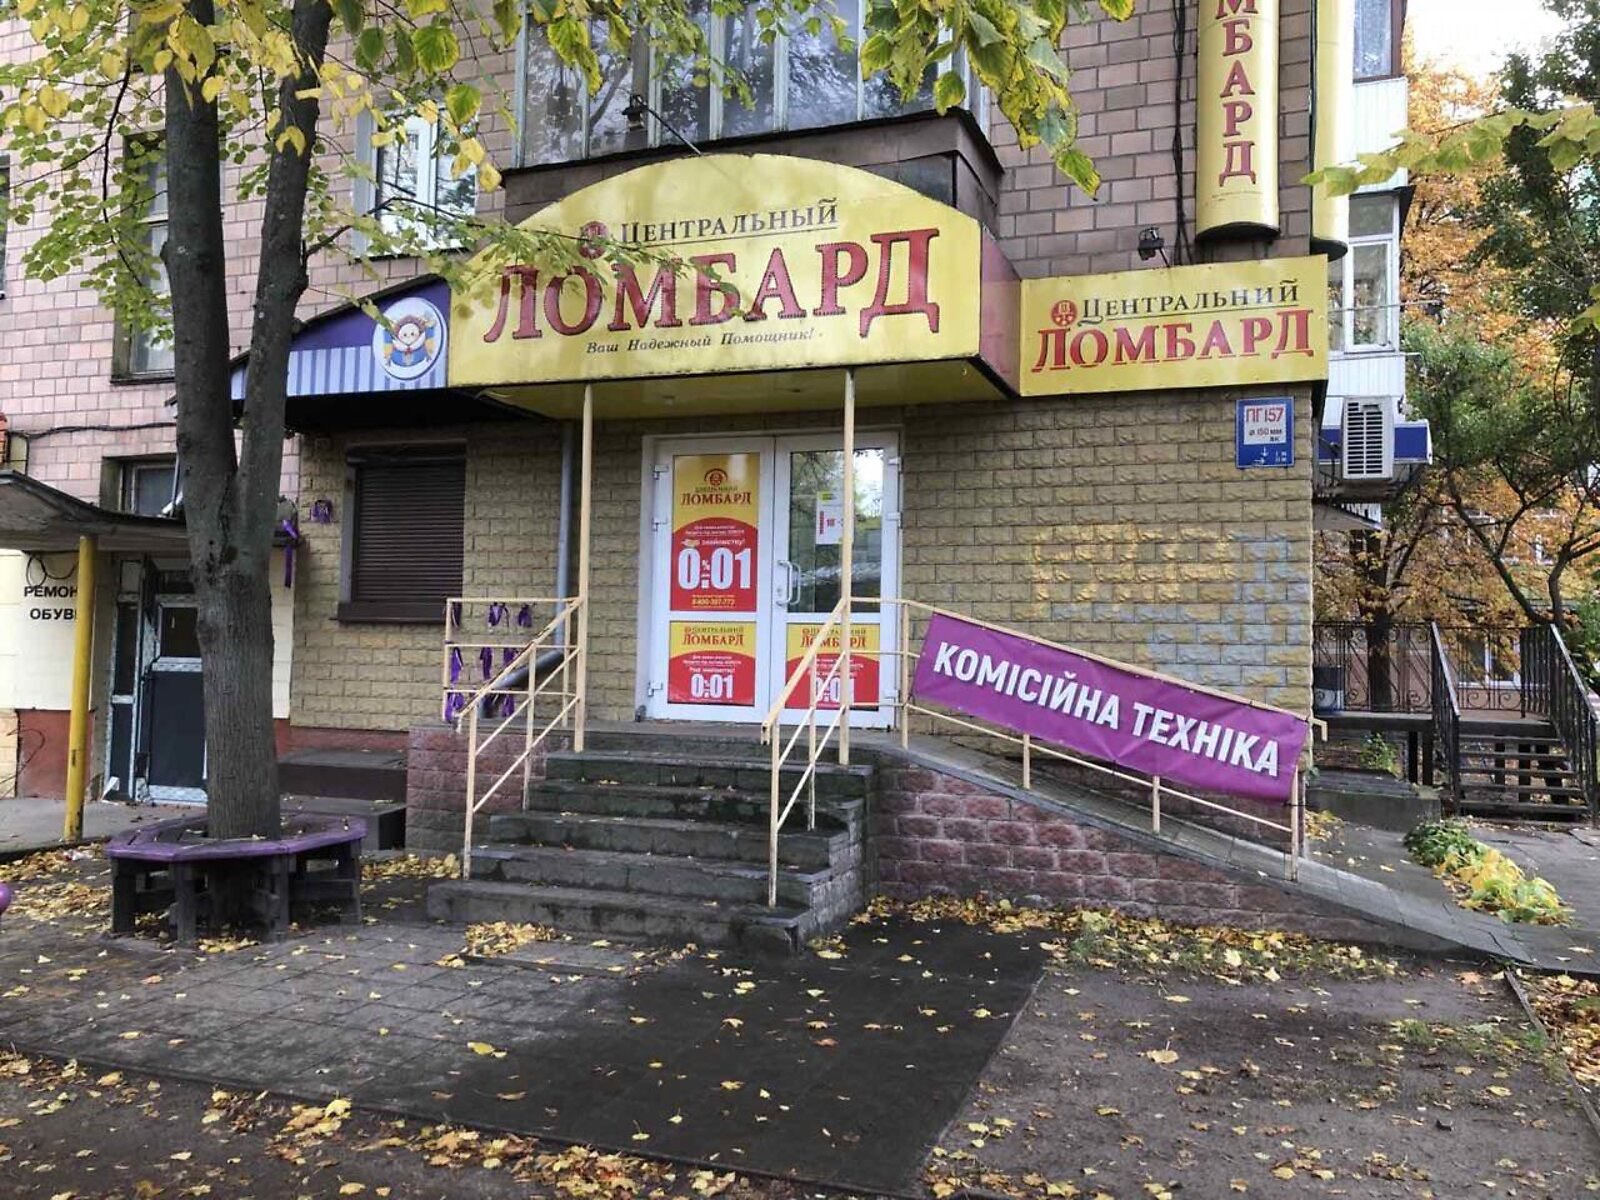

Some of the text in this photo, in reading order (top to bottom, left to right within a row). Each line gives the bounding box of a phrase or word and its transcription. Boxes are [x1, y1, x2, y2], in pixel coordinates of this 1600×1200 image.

[619, 197, 838, 249] ЦЕНТРАЛЬНЫЙ
[484, 229, 939, 342] ЛОМБАРД
[1077, 279, 1299, 327] ЦЕНТРАЛЬНИЙ
[586, 327, 815, 354] Ваш Надежный Помощник!
[1031, 309, 1314, 373] ЛОМБАРД
[681, 492, 752, 506] ЛОМБАРД
[24, 585, 78, 598] РЕМОН
[30, 608, 77, 620] ОБУВ
[682, 634, 745, 646] ЛОМБАРД
[933, 641, 1280, 778] КОМІСІЙНА ТЕХНІКА
